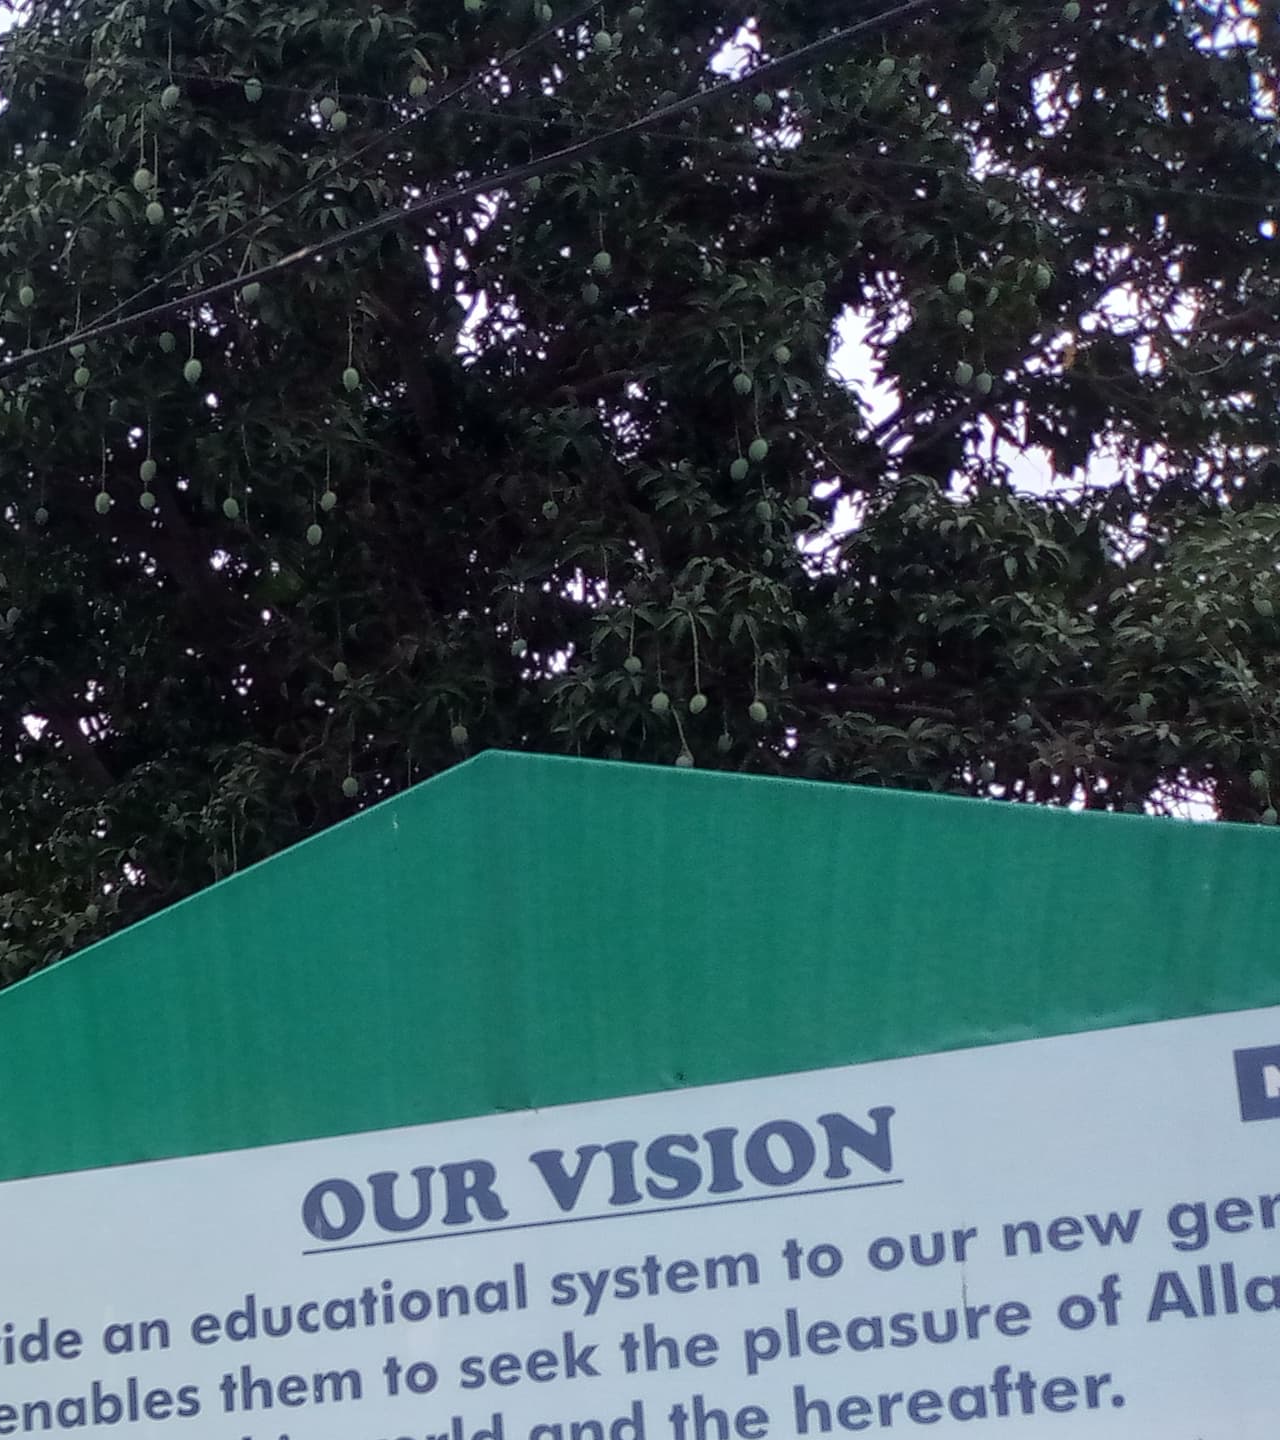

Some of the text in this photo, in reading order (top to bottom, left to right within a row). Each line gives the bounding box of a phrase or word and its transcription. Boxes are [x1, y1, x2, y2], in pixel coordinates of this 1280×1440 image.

[301, 1106, 896, 1241] OUR VISION
[103, 1318, 171, 1355] an
[191, 1261, 528, 1346] educational
[550, 1250, 760, 1317] system
[782, 1238, 843, 1281] to
[868, 1226, 978, 1272] our
[1002, 1207, 1144, 1258] new
[220, 1364, 363, 1414] them
[383, 1356, 438, 1396] to
[460, 1331, 601, 1390] seek
[620, 1322, 719, 1374] the
[744, 1301, 1032, 1377] pleasure
[1057, 1272, 1123, 1332] of
[792, 1364, 1126, 1436] hereafter.
